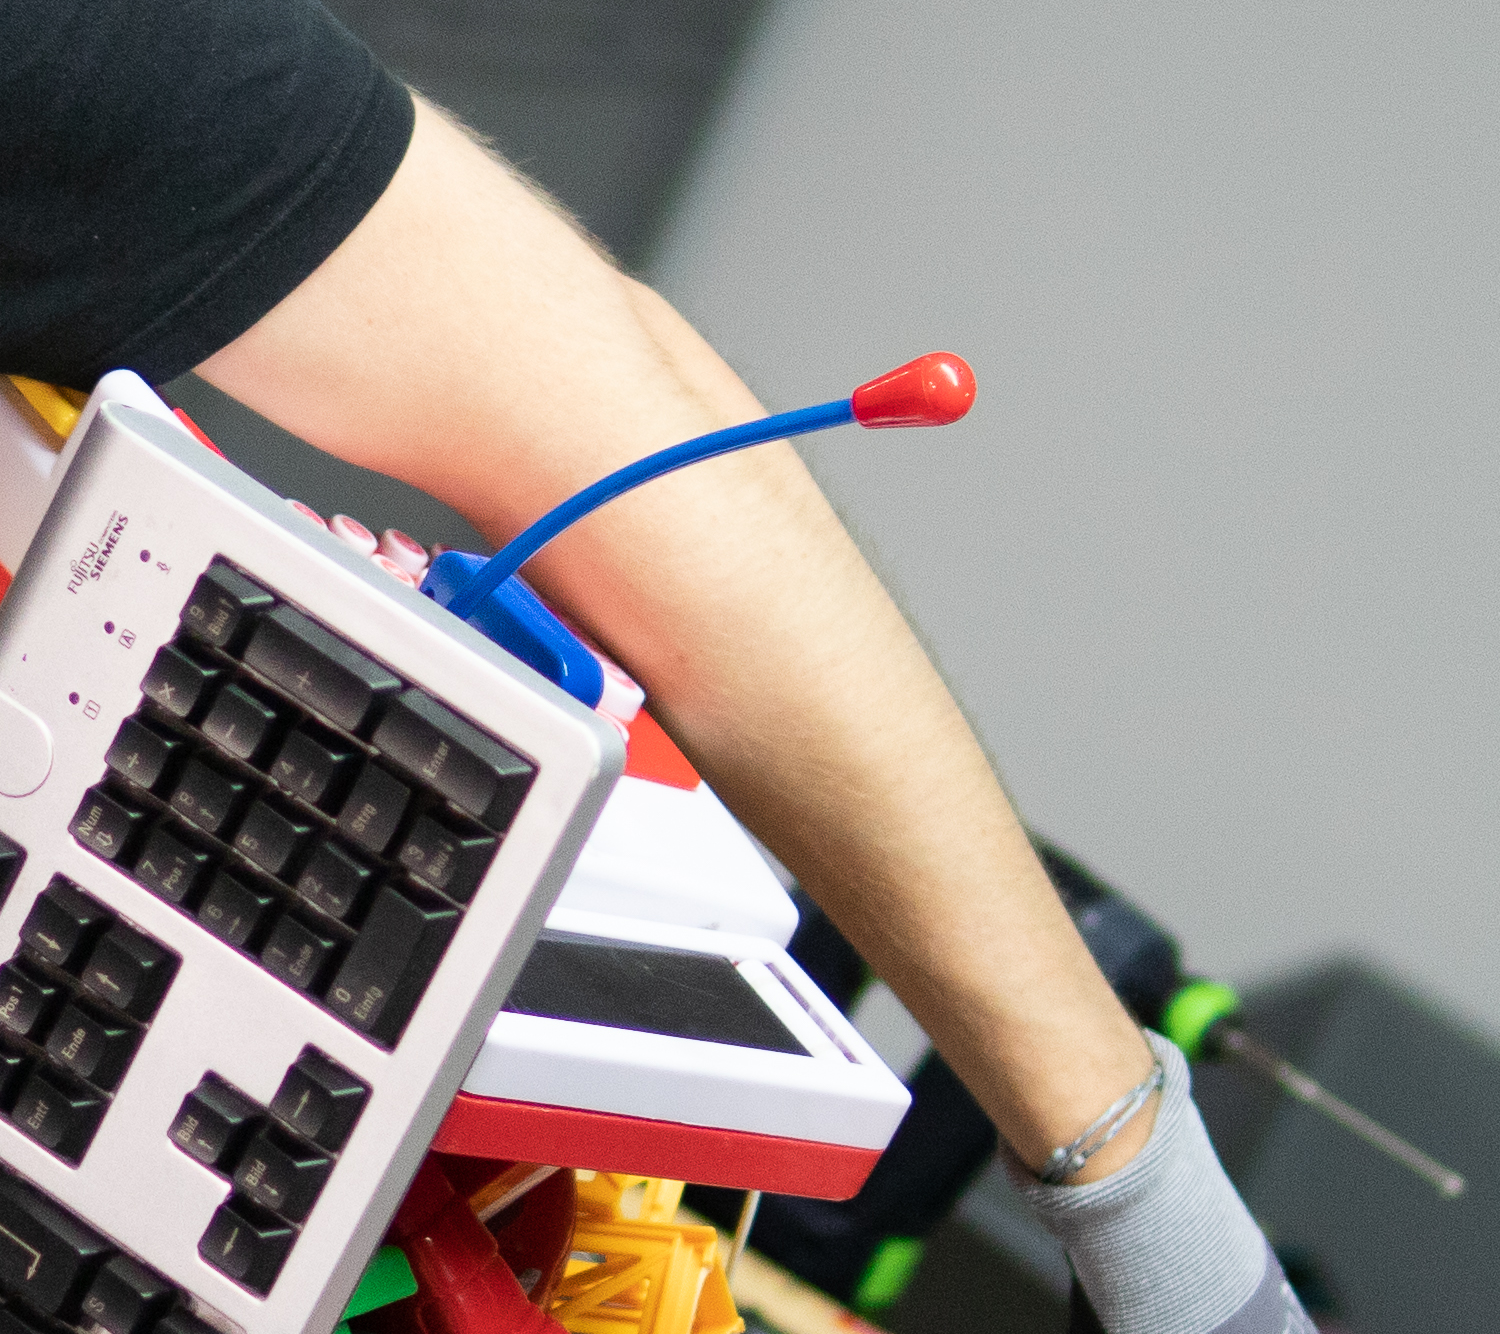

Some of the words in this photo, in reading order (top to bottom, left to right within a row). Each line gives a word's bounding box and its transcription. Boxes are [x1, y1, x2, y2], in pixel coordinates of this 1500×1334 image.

[88, 512, 129, 581] SIEMENS
[66, 540, 99, 594] FUJITSU
[206, 608, 230, 636] Bild
[421, 739, 451, 779] Enter
[77, 804, 103, 836] Num
[350, 802, 378, 833] Strg
[287, 943, 314, 976] Ende
[352, 984, 384, 1021] Einfg
[60, 1026, 87, 1060] Ende
[25, 1098, 50, 1130] Entf
[175, 1114, 200, 1142] Bild
[244, 1158, 267, 1187] Bild
